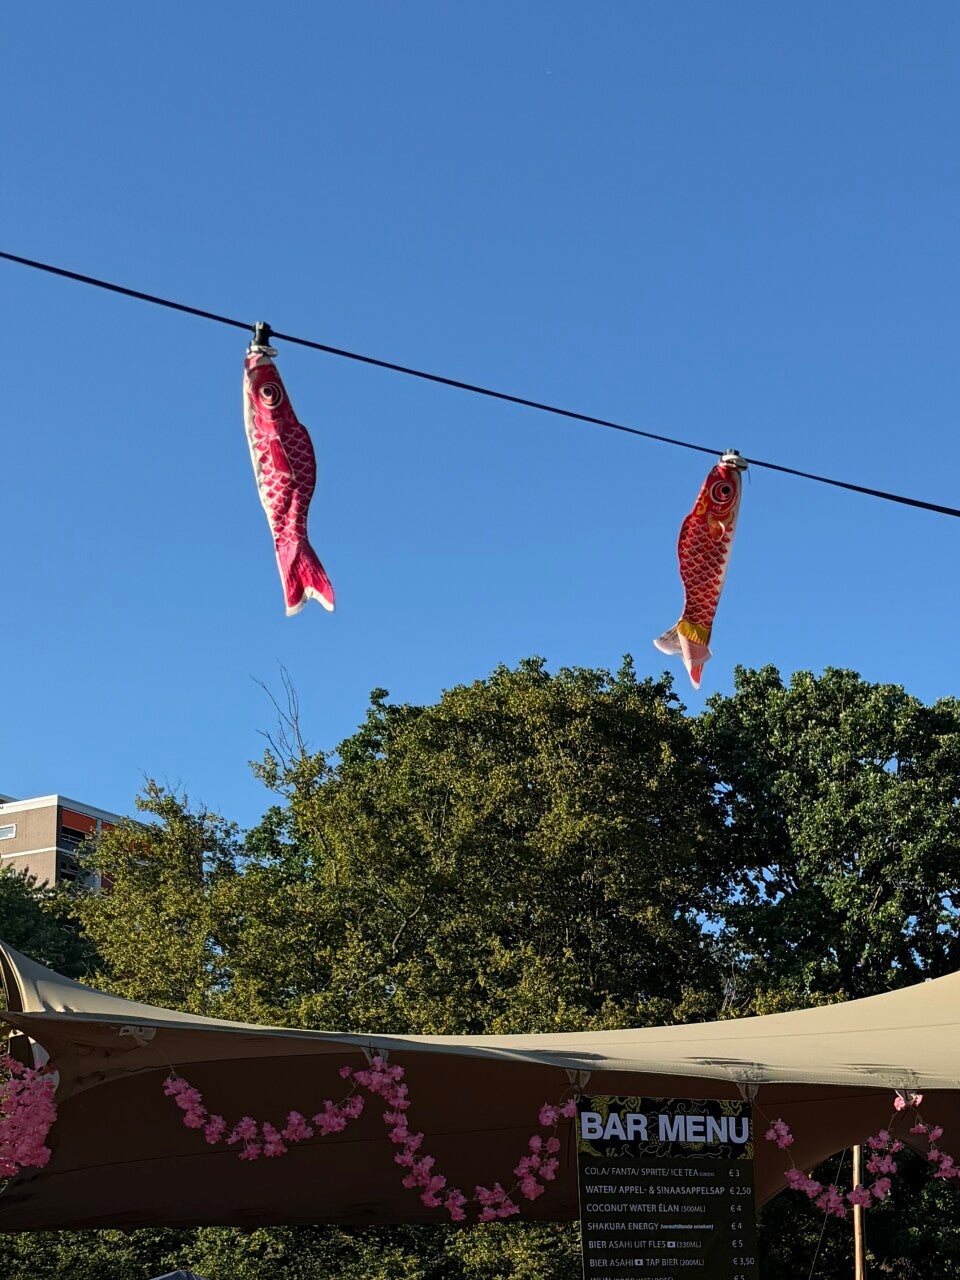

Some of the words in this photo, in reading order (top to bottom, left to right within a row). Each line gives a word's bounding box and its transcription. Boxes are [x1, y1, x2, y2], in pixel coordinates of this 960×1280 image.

[581, 1112, 648, 1140] BAR
[659, 1114, 749, 1144] MENU
[585, 1167, 609, 1176] COLA/
[611, 1168, 639, 1176] FANTA/
[641, 1168, 670, 1176] SPRITE/
[671, 1168, 683, 1176] ICE
[684, 1169, 698, 1177] TEA
[586, 1185, 617, 1194] WATER/
[619, 1186, 647, 1194] APPEL-
[649, 1186, 655, 1194] &
[656, 1186, 725, 1195] SINAASAPPELSAP
[587, 1204, 627, 1212] COCONUT
[630, 1204, 656, 1212] WATER
[659, 1203, 679, 1212] ÉLAN
